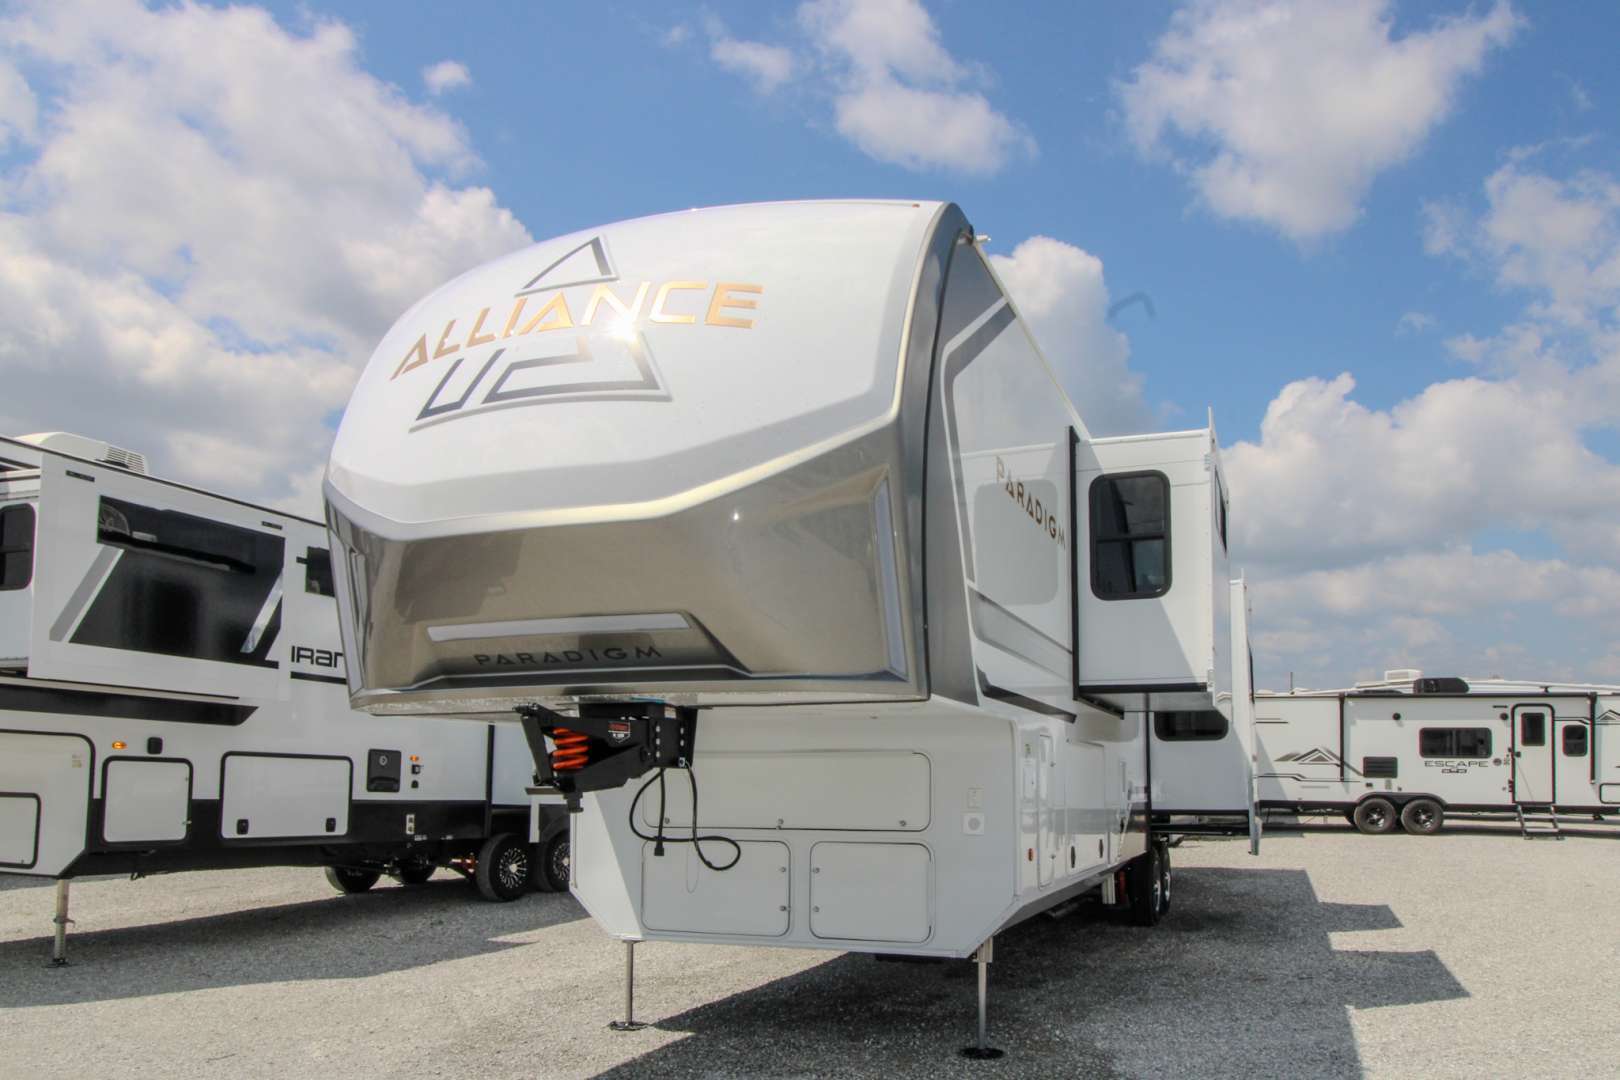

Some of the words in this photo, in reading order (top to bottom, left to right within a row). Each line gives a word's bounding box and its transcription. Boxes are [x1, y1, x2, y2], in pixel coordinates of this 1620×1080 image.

[390, 280, 763, 381] ALLIANCE
[995, 455, 1066, 550] PARADIGM
[473, 646, 662, 666] PARADIGM
[1424, 760, 1489, 768] ESCAPE
